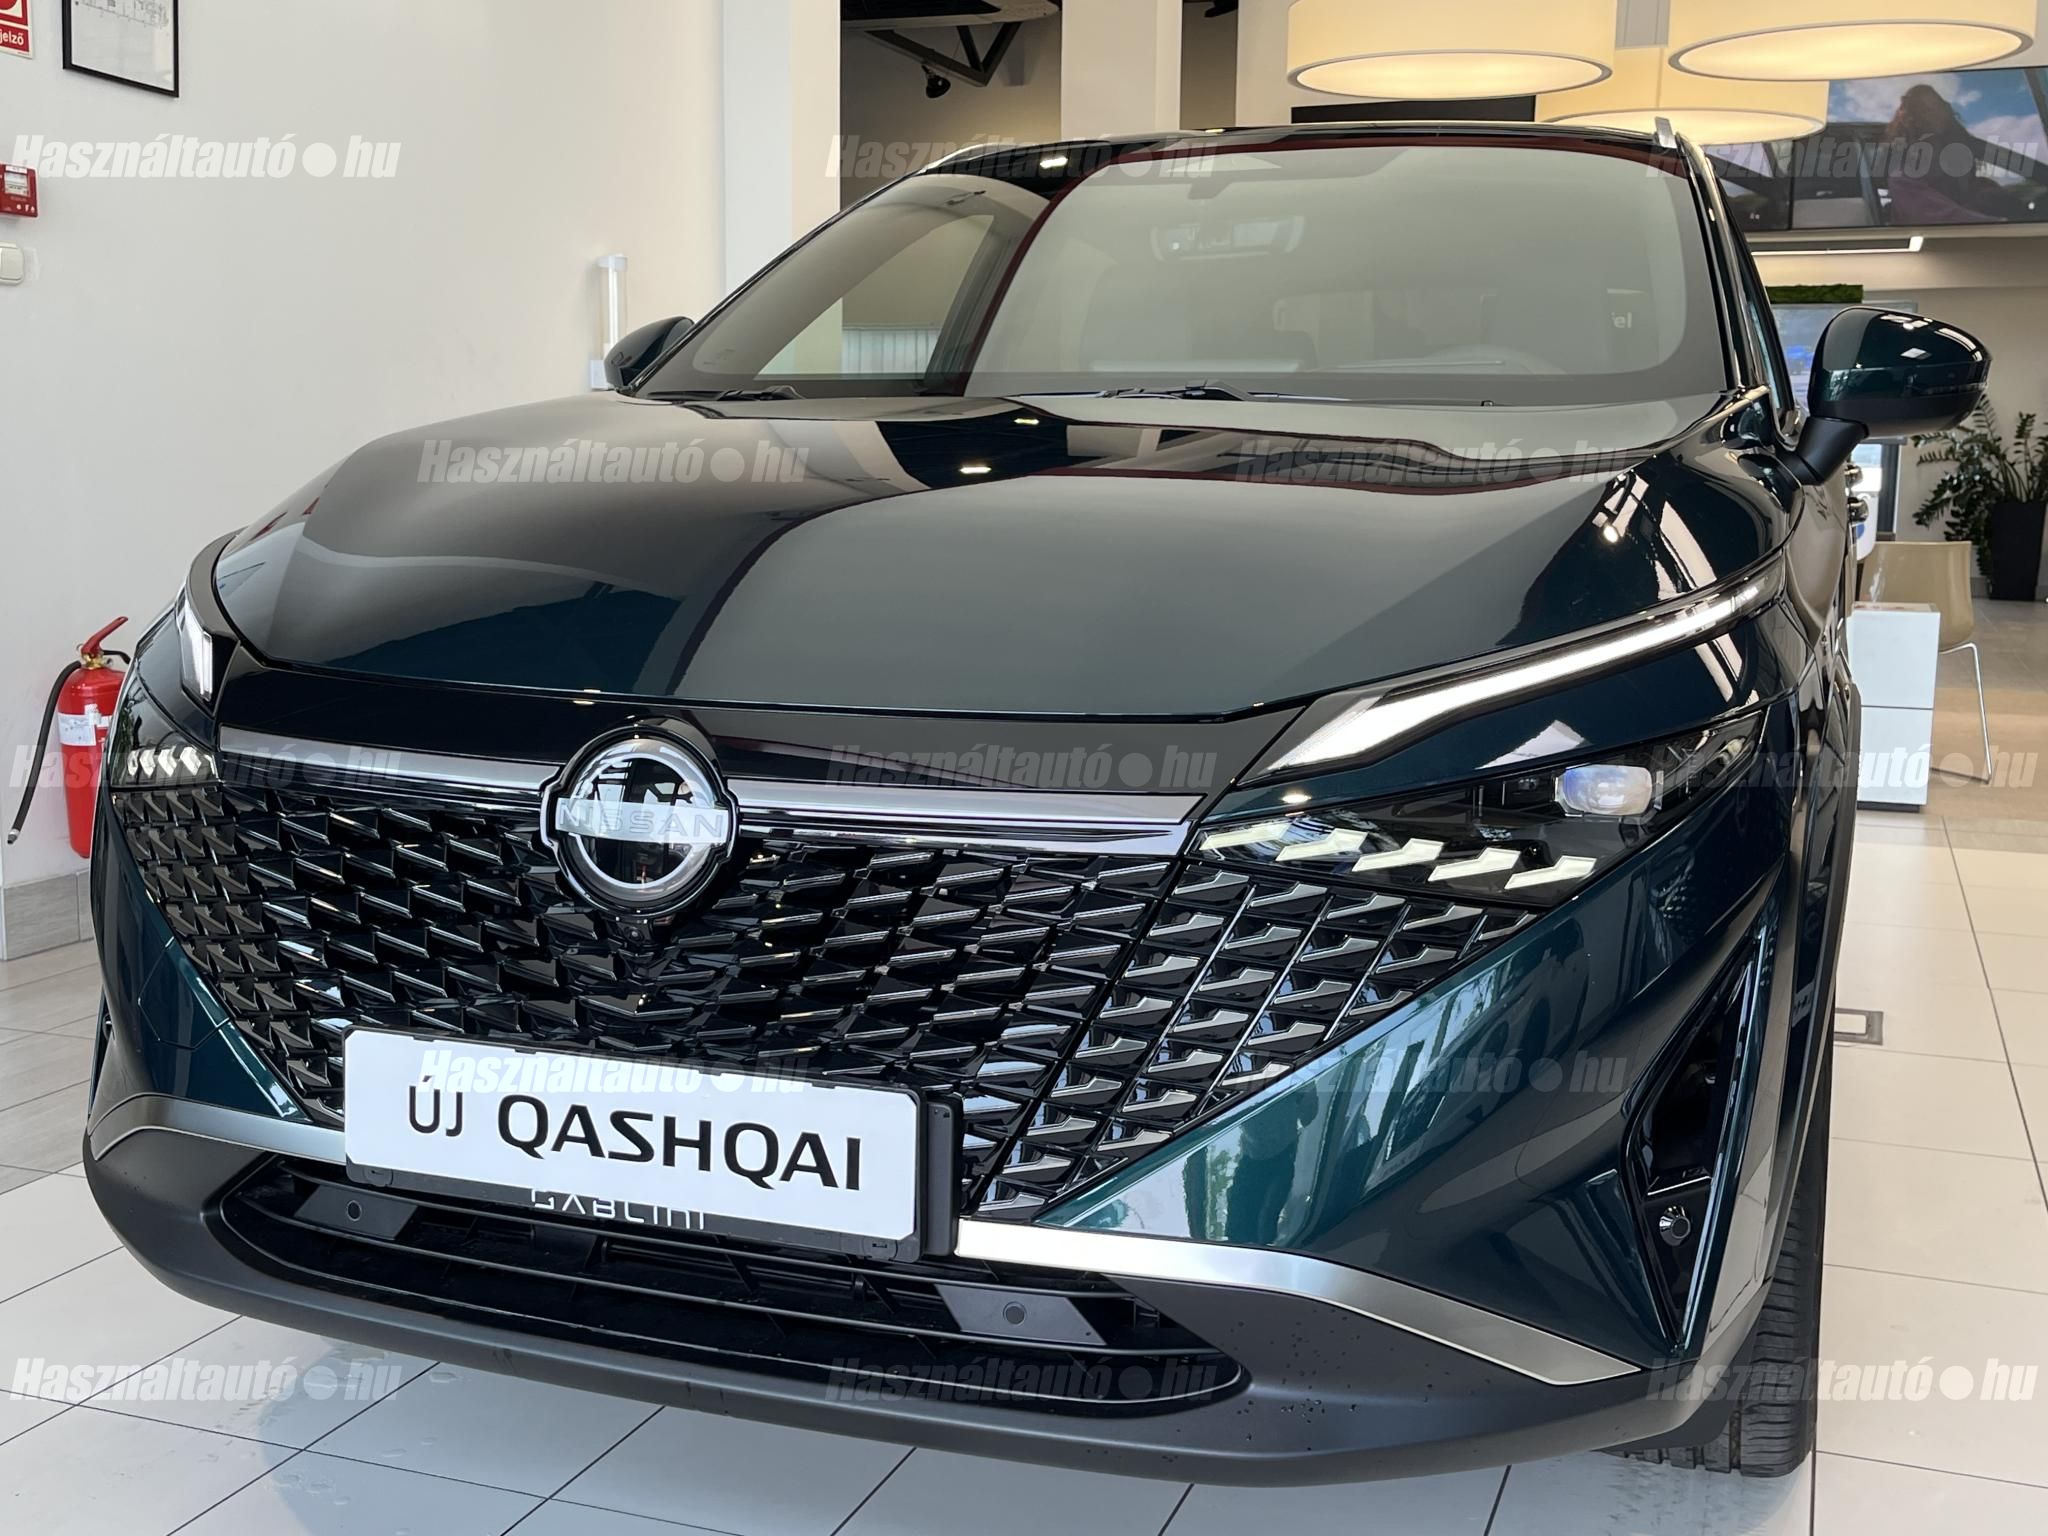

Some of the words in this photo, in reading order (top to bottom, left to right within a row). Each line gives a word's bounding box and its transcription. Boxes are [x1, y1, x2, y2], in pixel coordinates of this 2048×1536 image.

[559, 802, 724, 838] NISSAN
[409, 1074, 464, 1136] ÚJ
[497, 1093, 862, 1190] QASHQAI
